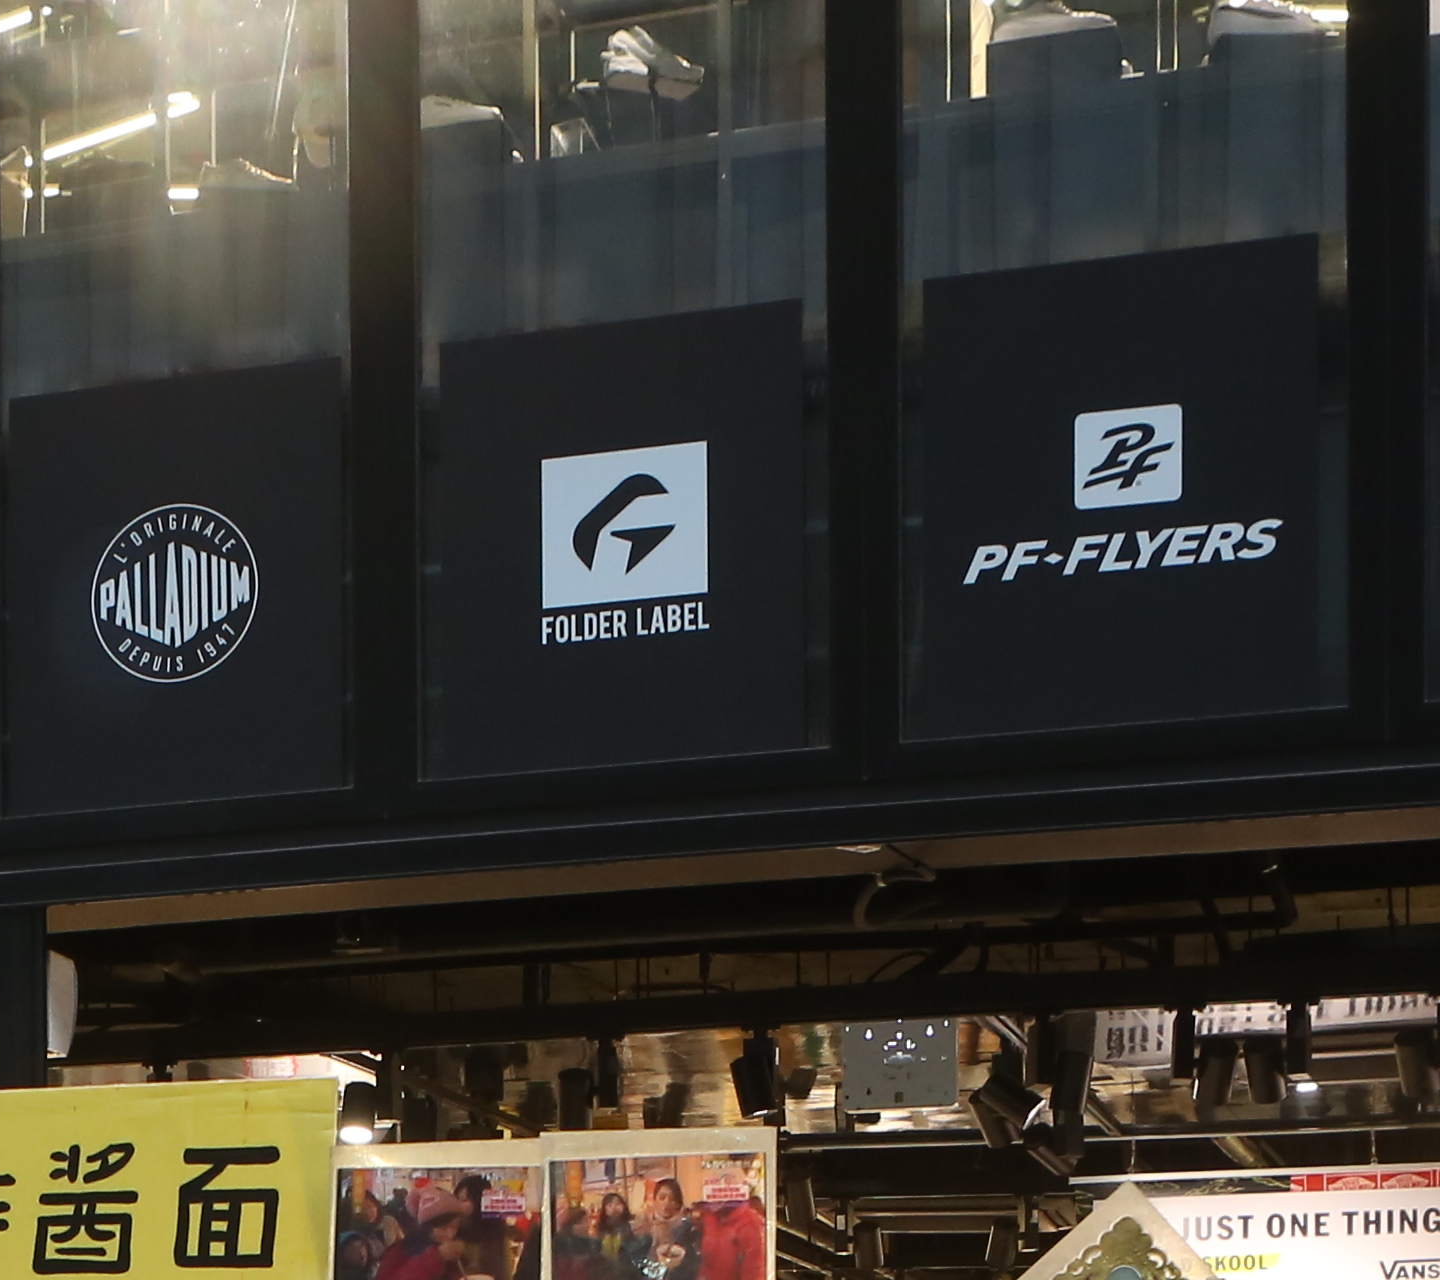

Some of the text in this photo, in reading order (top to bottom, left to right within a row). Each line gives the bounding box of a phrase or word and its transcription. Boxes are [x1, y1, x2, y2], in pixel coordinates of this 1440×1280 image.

[113, 513, 237, 564] L'ORIGINALE
[100, 541, 250, 648] PALLADIUM
[118, 622, 235, 672] DEPUIS 1947
[541, 601, 710, 645] FOLDER LABEL
[1266, 1212, 1330, 1239] ONE
